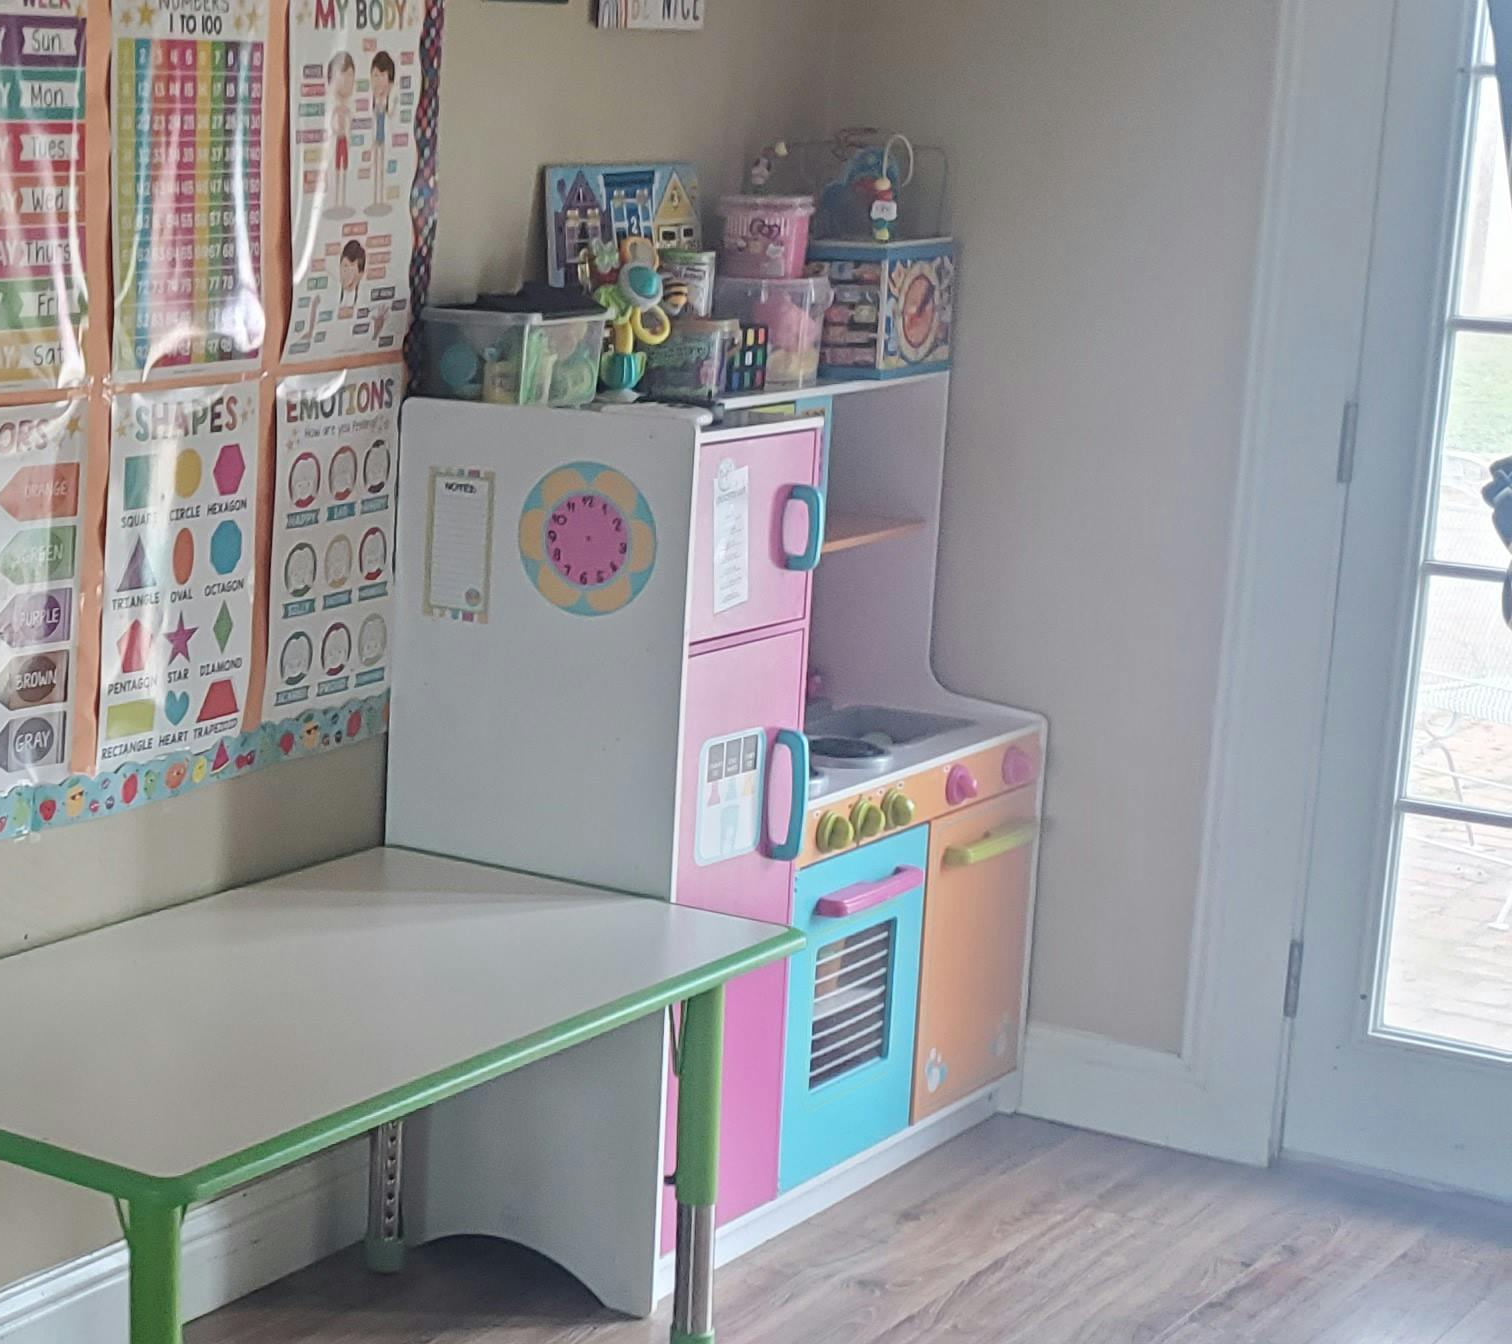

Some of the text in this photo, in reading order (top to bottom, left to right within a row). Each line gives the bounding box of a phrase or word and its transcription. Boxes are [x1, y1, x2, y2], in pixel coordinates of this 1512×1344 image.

[169, 13, 223, 35] 1 TO 100
[286, 378, 394, 423] EMOTIONS
[135, 396, 238, 441] SHAPES
[25, 480, 68, 496] ORANGE
[169, 499, 247, 522] CIRCLE HEXAGON
[566, 501, 576, 513] 11
[552, 514, 567, 526] 10
[612, 518, 623, 532] 2
[548, 530, 557, 543] 9
[18, 544, 63, 563] REEN
[553, 548, 561, 562] 8
[619, 542, 627, 555] 3
[564, 564, 571, 576] 7
[580, 571, 588, 585] 6
[596, 570, 604, 584] 5
[112, 578, 245, 611] TRIANGLE OVAL OCTAGON
[21, 608, 60, 627] PURPLE
[16, 669, 57, 690] BROWN
[107, 657, 243, 697] PENTAGON STAR DIAMOND
[16, 731, 51, 753] GRAY
[101, 718, 238, 760] RECTANGLE HEART TRAPEZOID
